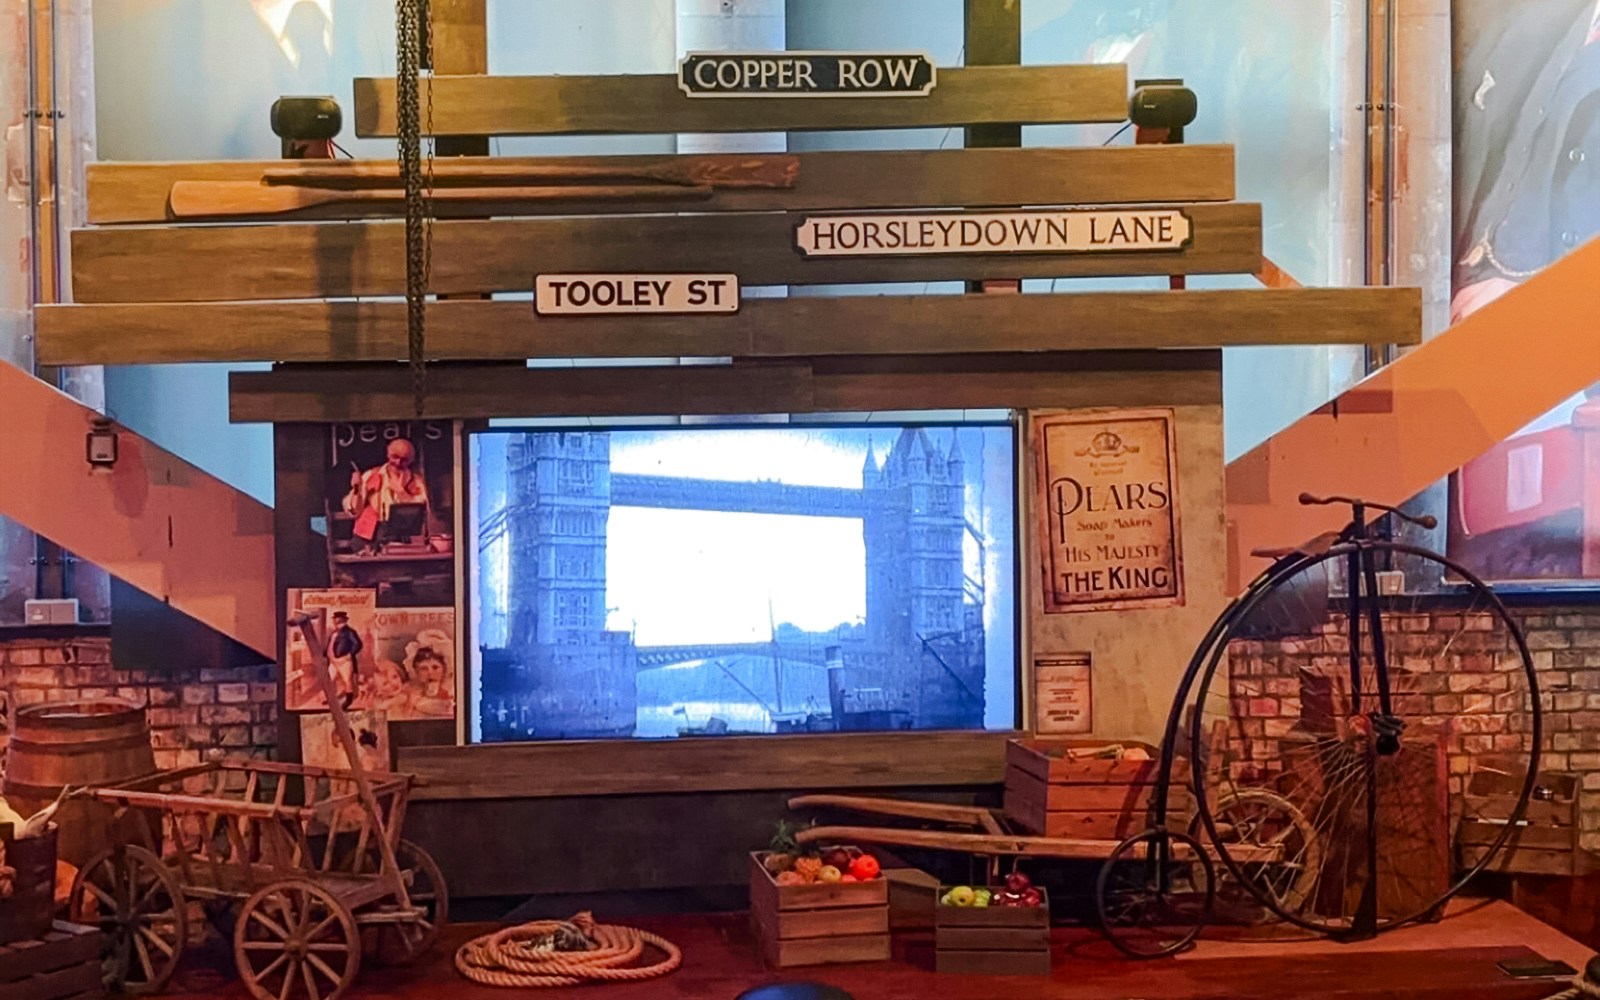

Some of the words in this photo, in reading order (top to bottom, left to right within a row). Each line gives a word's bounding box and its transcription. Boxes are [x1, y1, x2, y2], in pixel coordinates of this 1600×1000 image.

[694, 59, 817, 89] COPPER
[837, 58, 918, 88] ROW
[812, 217, 1069, 250] HORSLEYDOWN
[1089, 215, 1174, 245] LANE
[548, 280, 672, 307] TOOLEY
[687, 279, 727, 306] ST
[1061, 571, 1104, 593] THE
[1108, 565, 1168, 590] KING
